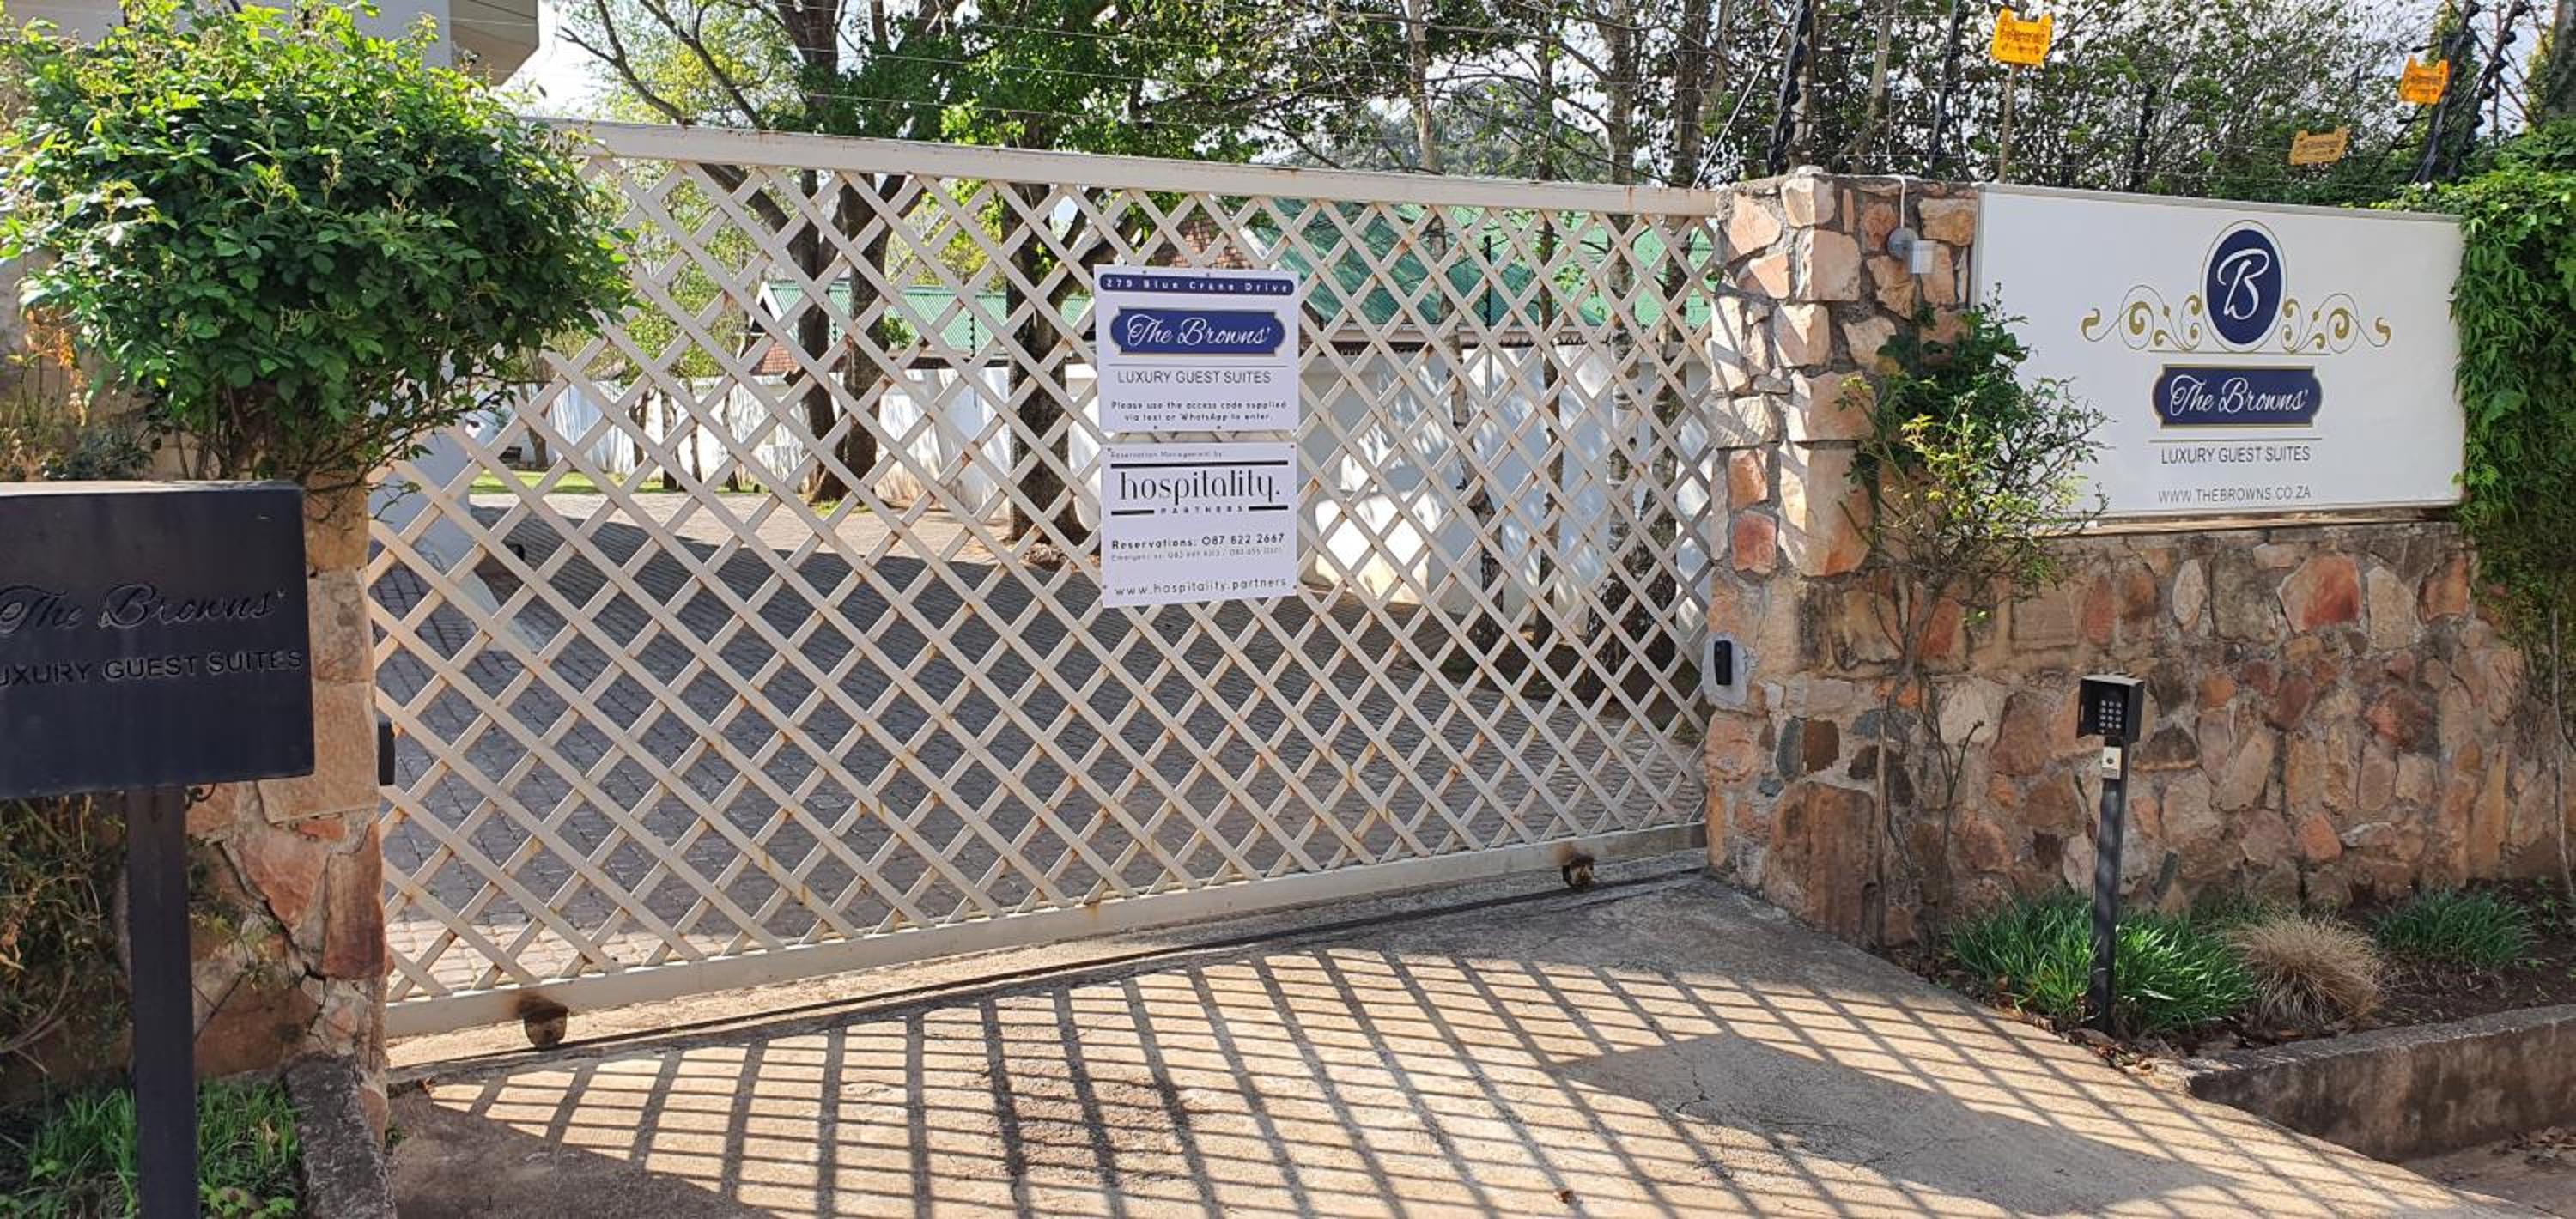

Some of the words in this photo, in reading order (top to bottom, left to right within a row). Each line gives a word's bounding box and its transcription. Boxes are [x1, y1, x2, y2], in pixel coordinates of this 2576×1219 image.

[1107, 278, 1133, 288] 279
[1143, 279, 1178, 289] Blue
[1189, 281, 1234, 291] Crane
[1244, 282, 1288, 292] Drive
[2217, 248, 2269, 320] B
[1127, 314, 1173, 347] The
[1177, 317, 1271, 346] Browns'
[1118, 371, 1171, 383] LUXURY
[1176, 371, 1219, 384] GUEST
[1224, 371, 1271, 384] SUITES
[2170, 374, 2215, 416] The
[2218, 377, 2309, 414] Browns'
[1112, 401, 1142, 409] Please
[1168, 401, 1182, 409] the
[1246, 401, 1286, 409] supplied
[2161, 447, 2215, 464] LUXURY
[2219, 447, 2262, 463] GUEST
[2266, 446, 2310, 462] SUITES
[1120, 470, 1280, 506] hospitality.
[1160, 506, 1242, 514] PARTNERS
[1112, 539, 1196, 549] Reservations:
[1202, 535, 1224, 546] 087
[1256, 533, 1285, 543] 2667
[1115, 579, 1287, 596] www.hospitality.partners
[0, 585, 83, 637] The
[0, 664, 92, 686] UXURY
[104, 655, 197, 680] GUEST
[207, 650, 301, 674] SUITES
